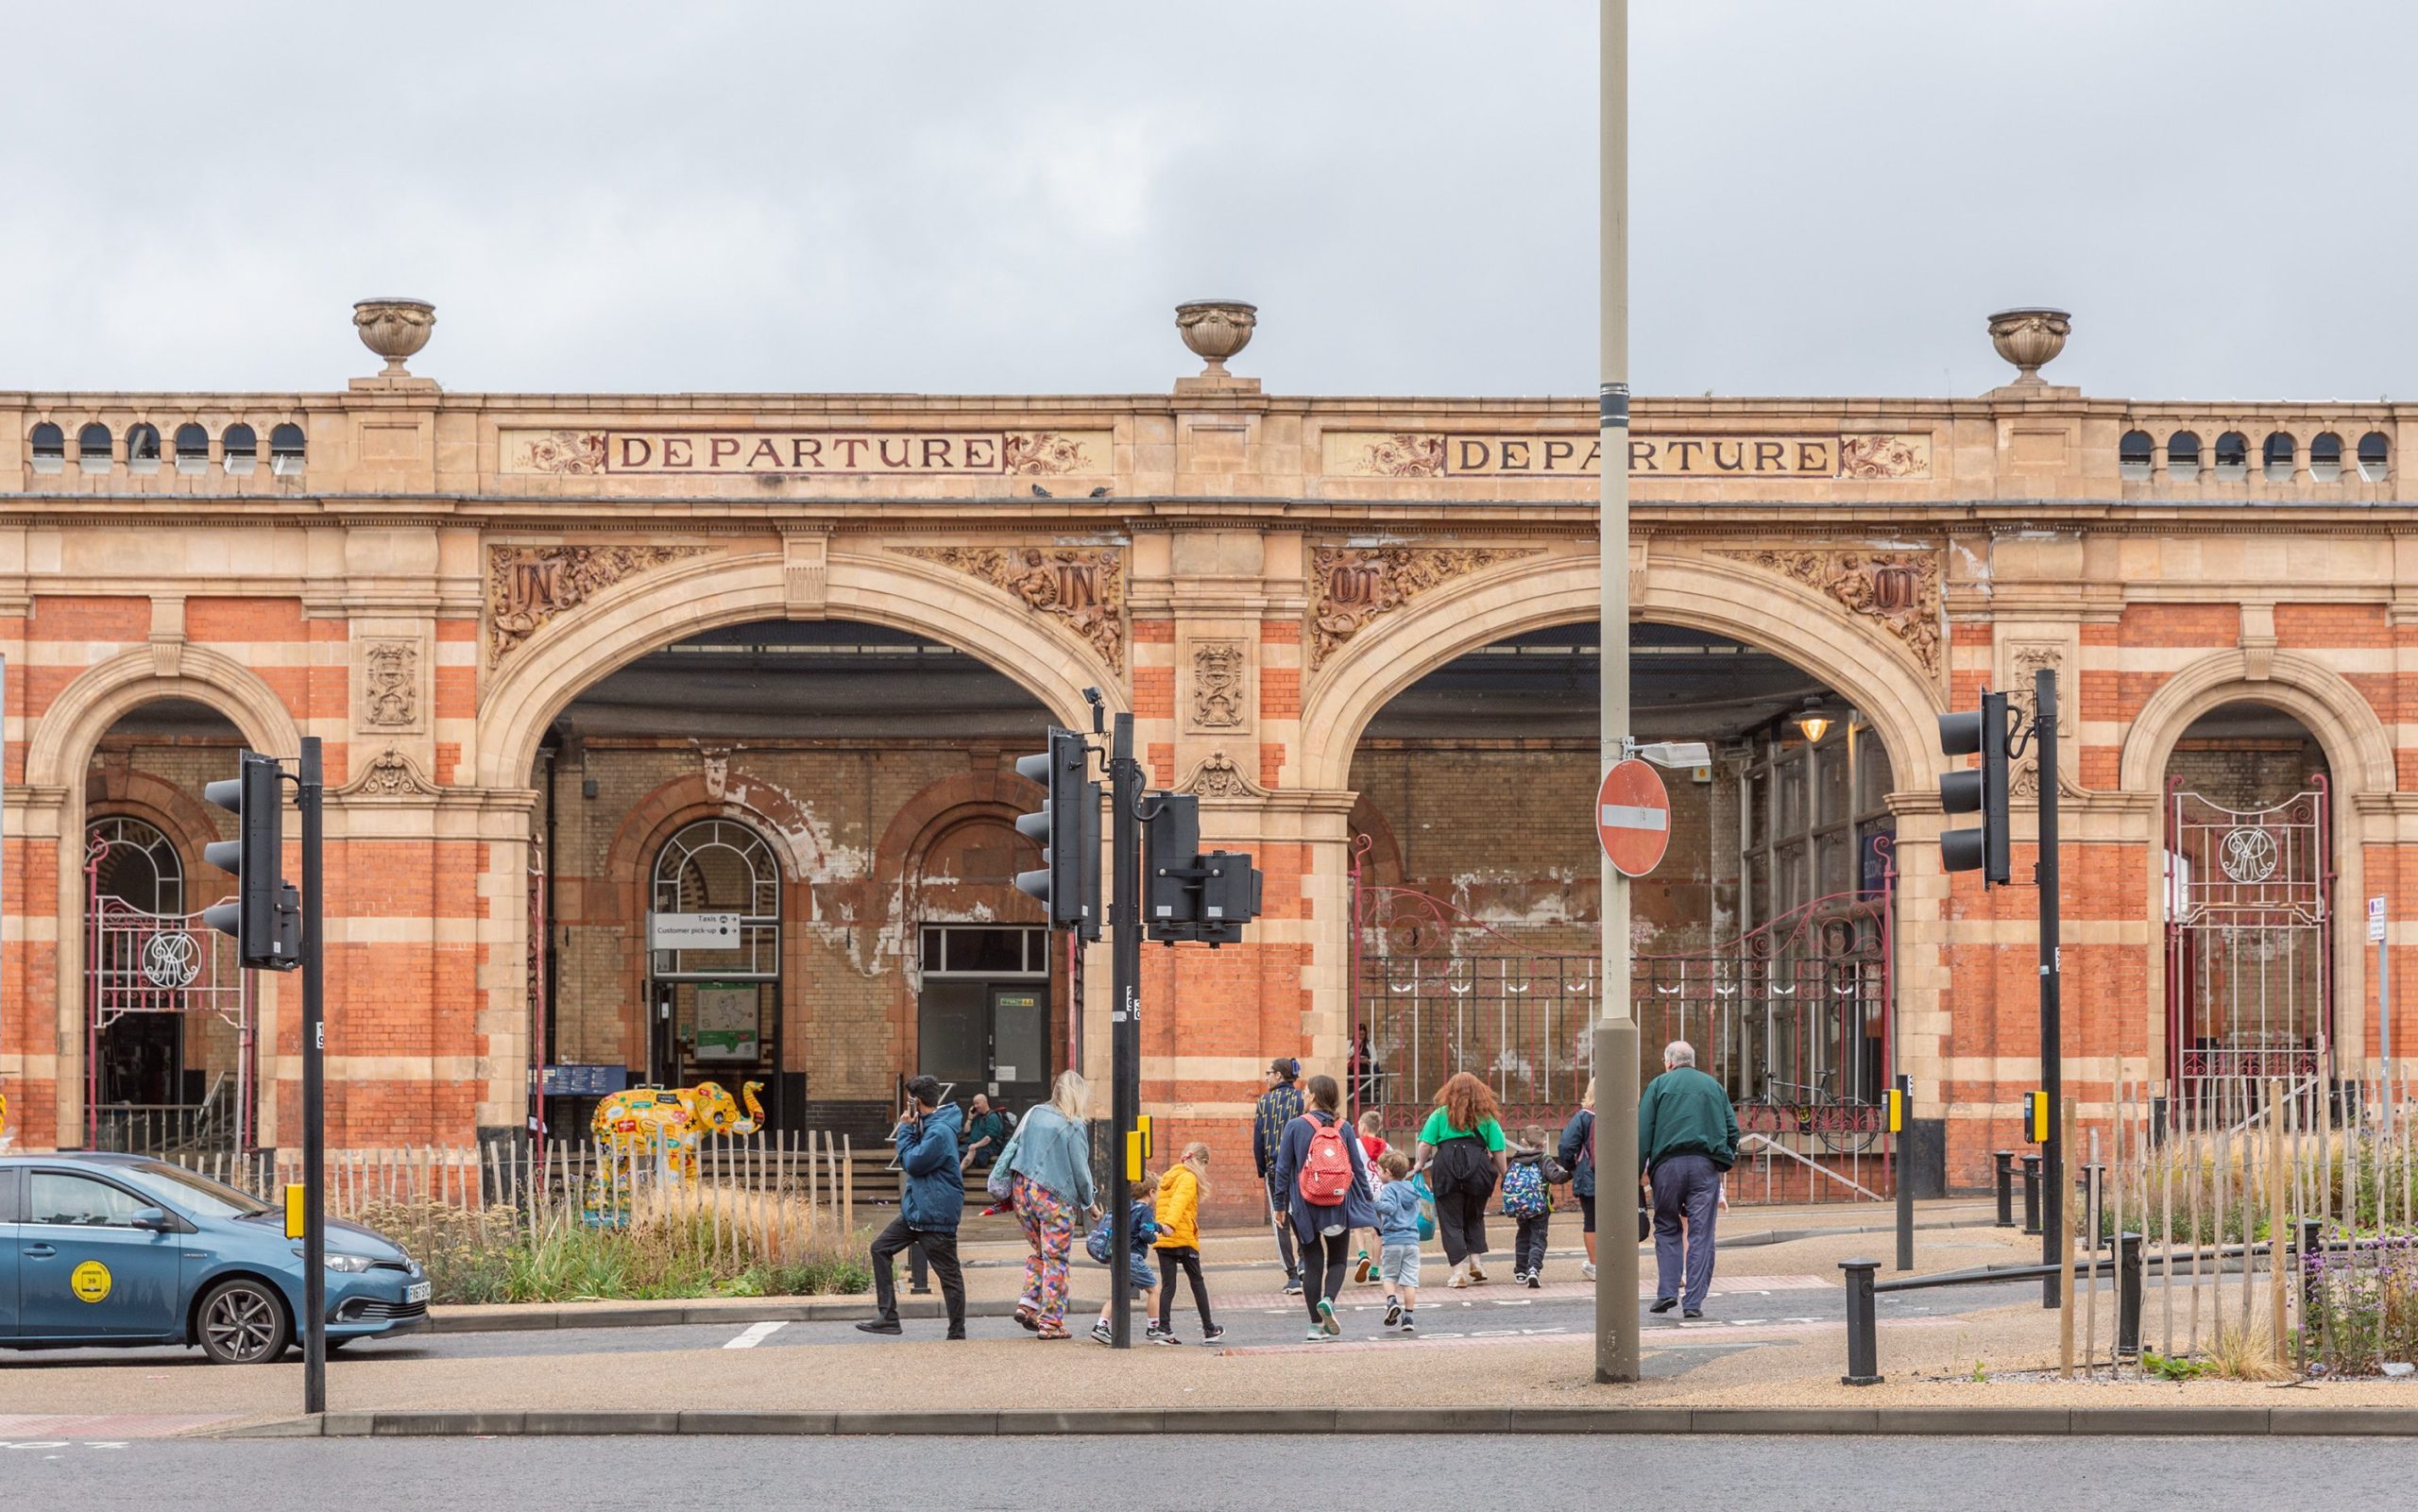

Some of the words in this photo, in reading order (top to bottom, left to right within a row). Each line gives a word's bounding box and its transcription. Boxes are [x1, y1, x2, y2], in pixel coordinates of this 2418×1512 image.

[621, 437, 996, 467] DEPARTURE
[1459, 440, 1829, 472] DEPARTURE
[690, 926, 717, 936] pick-up
